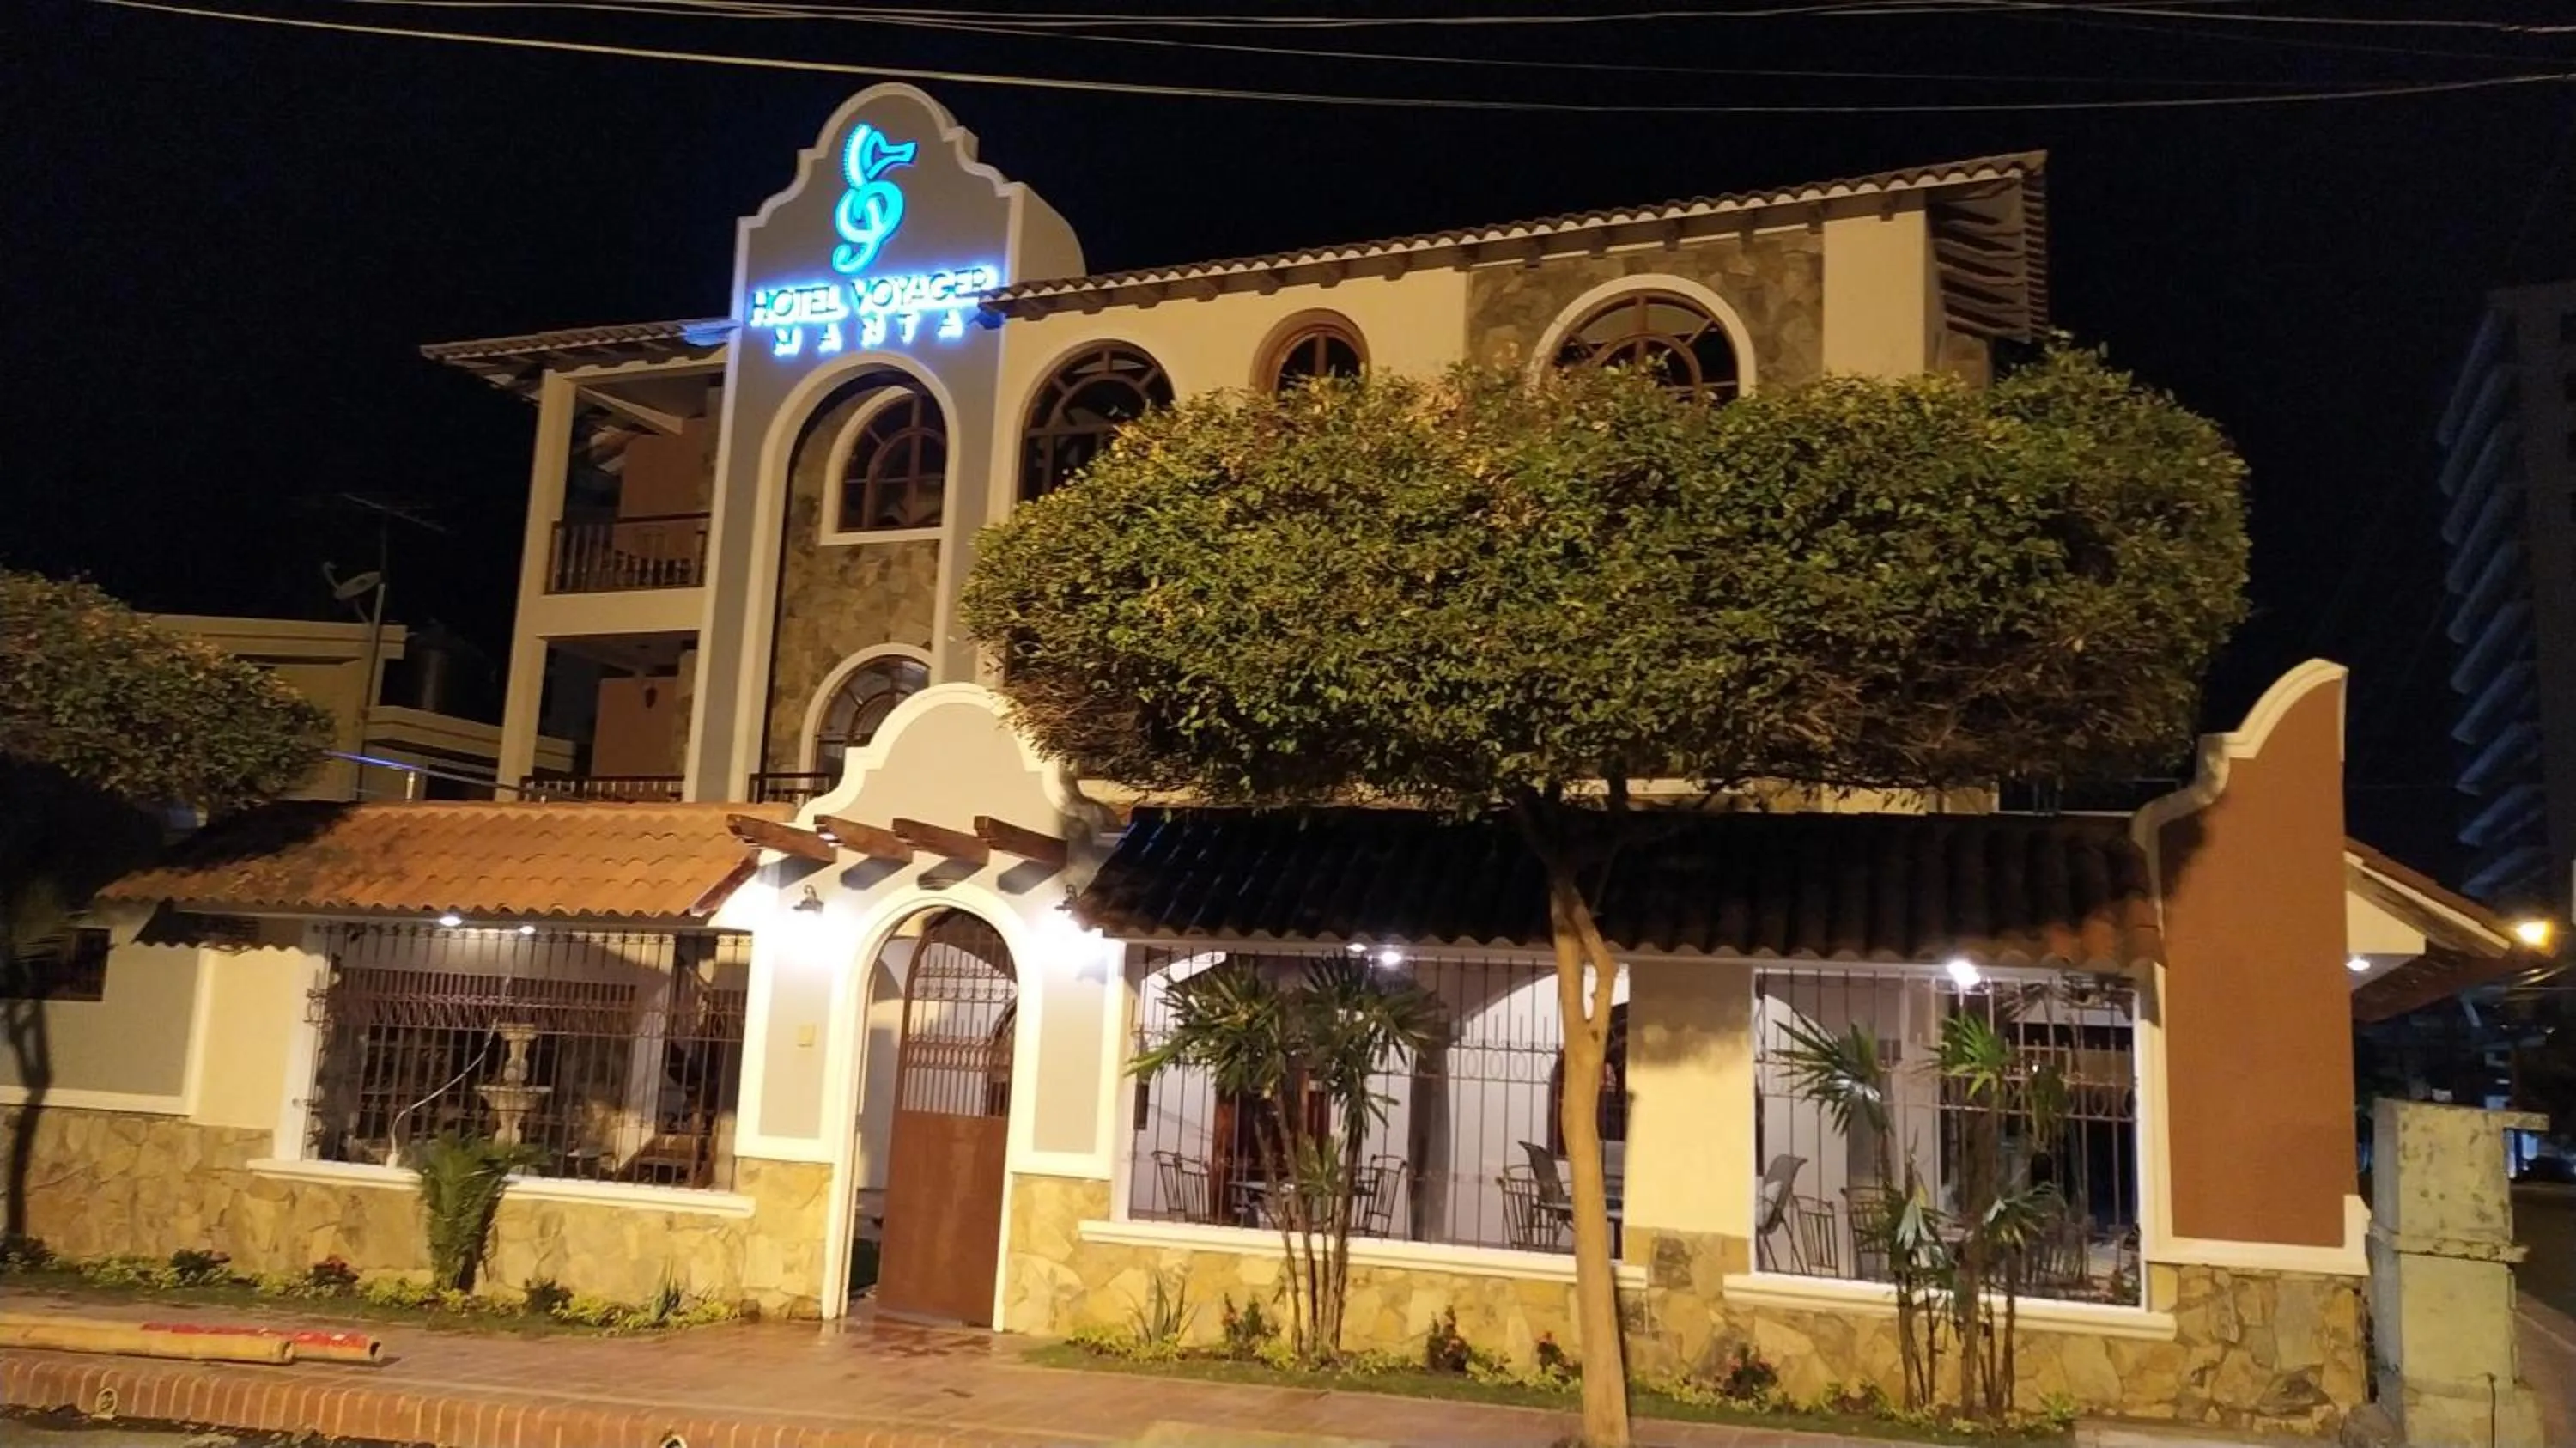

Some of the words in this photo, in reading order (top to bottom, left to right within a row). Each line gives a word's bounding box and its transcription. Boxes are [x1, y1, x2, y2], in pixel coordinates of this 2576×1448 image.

[752, 285, 845, 325] HOTEL
[851, 267, 995, 313] VOYAGER
[773, 309, 963, 356] MANTA
